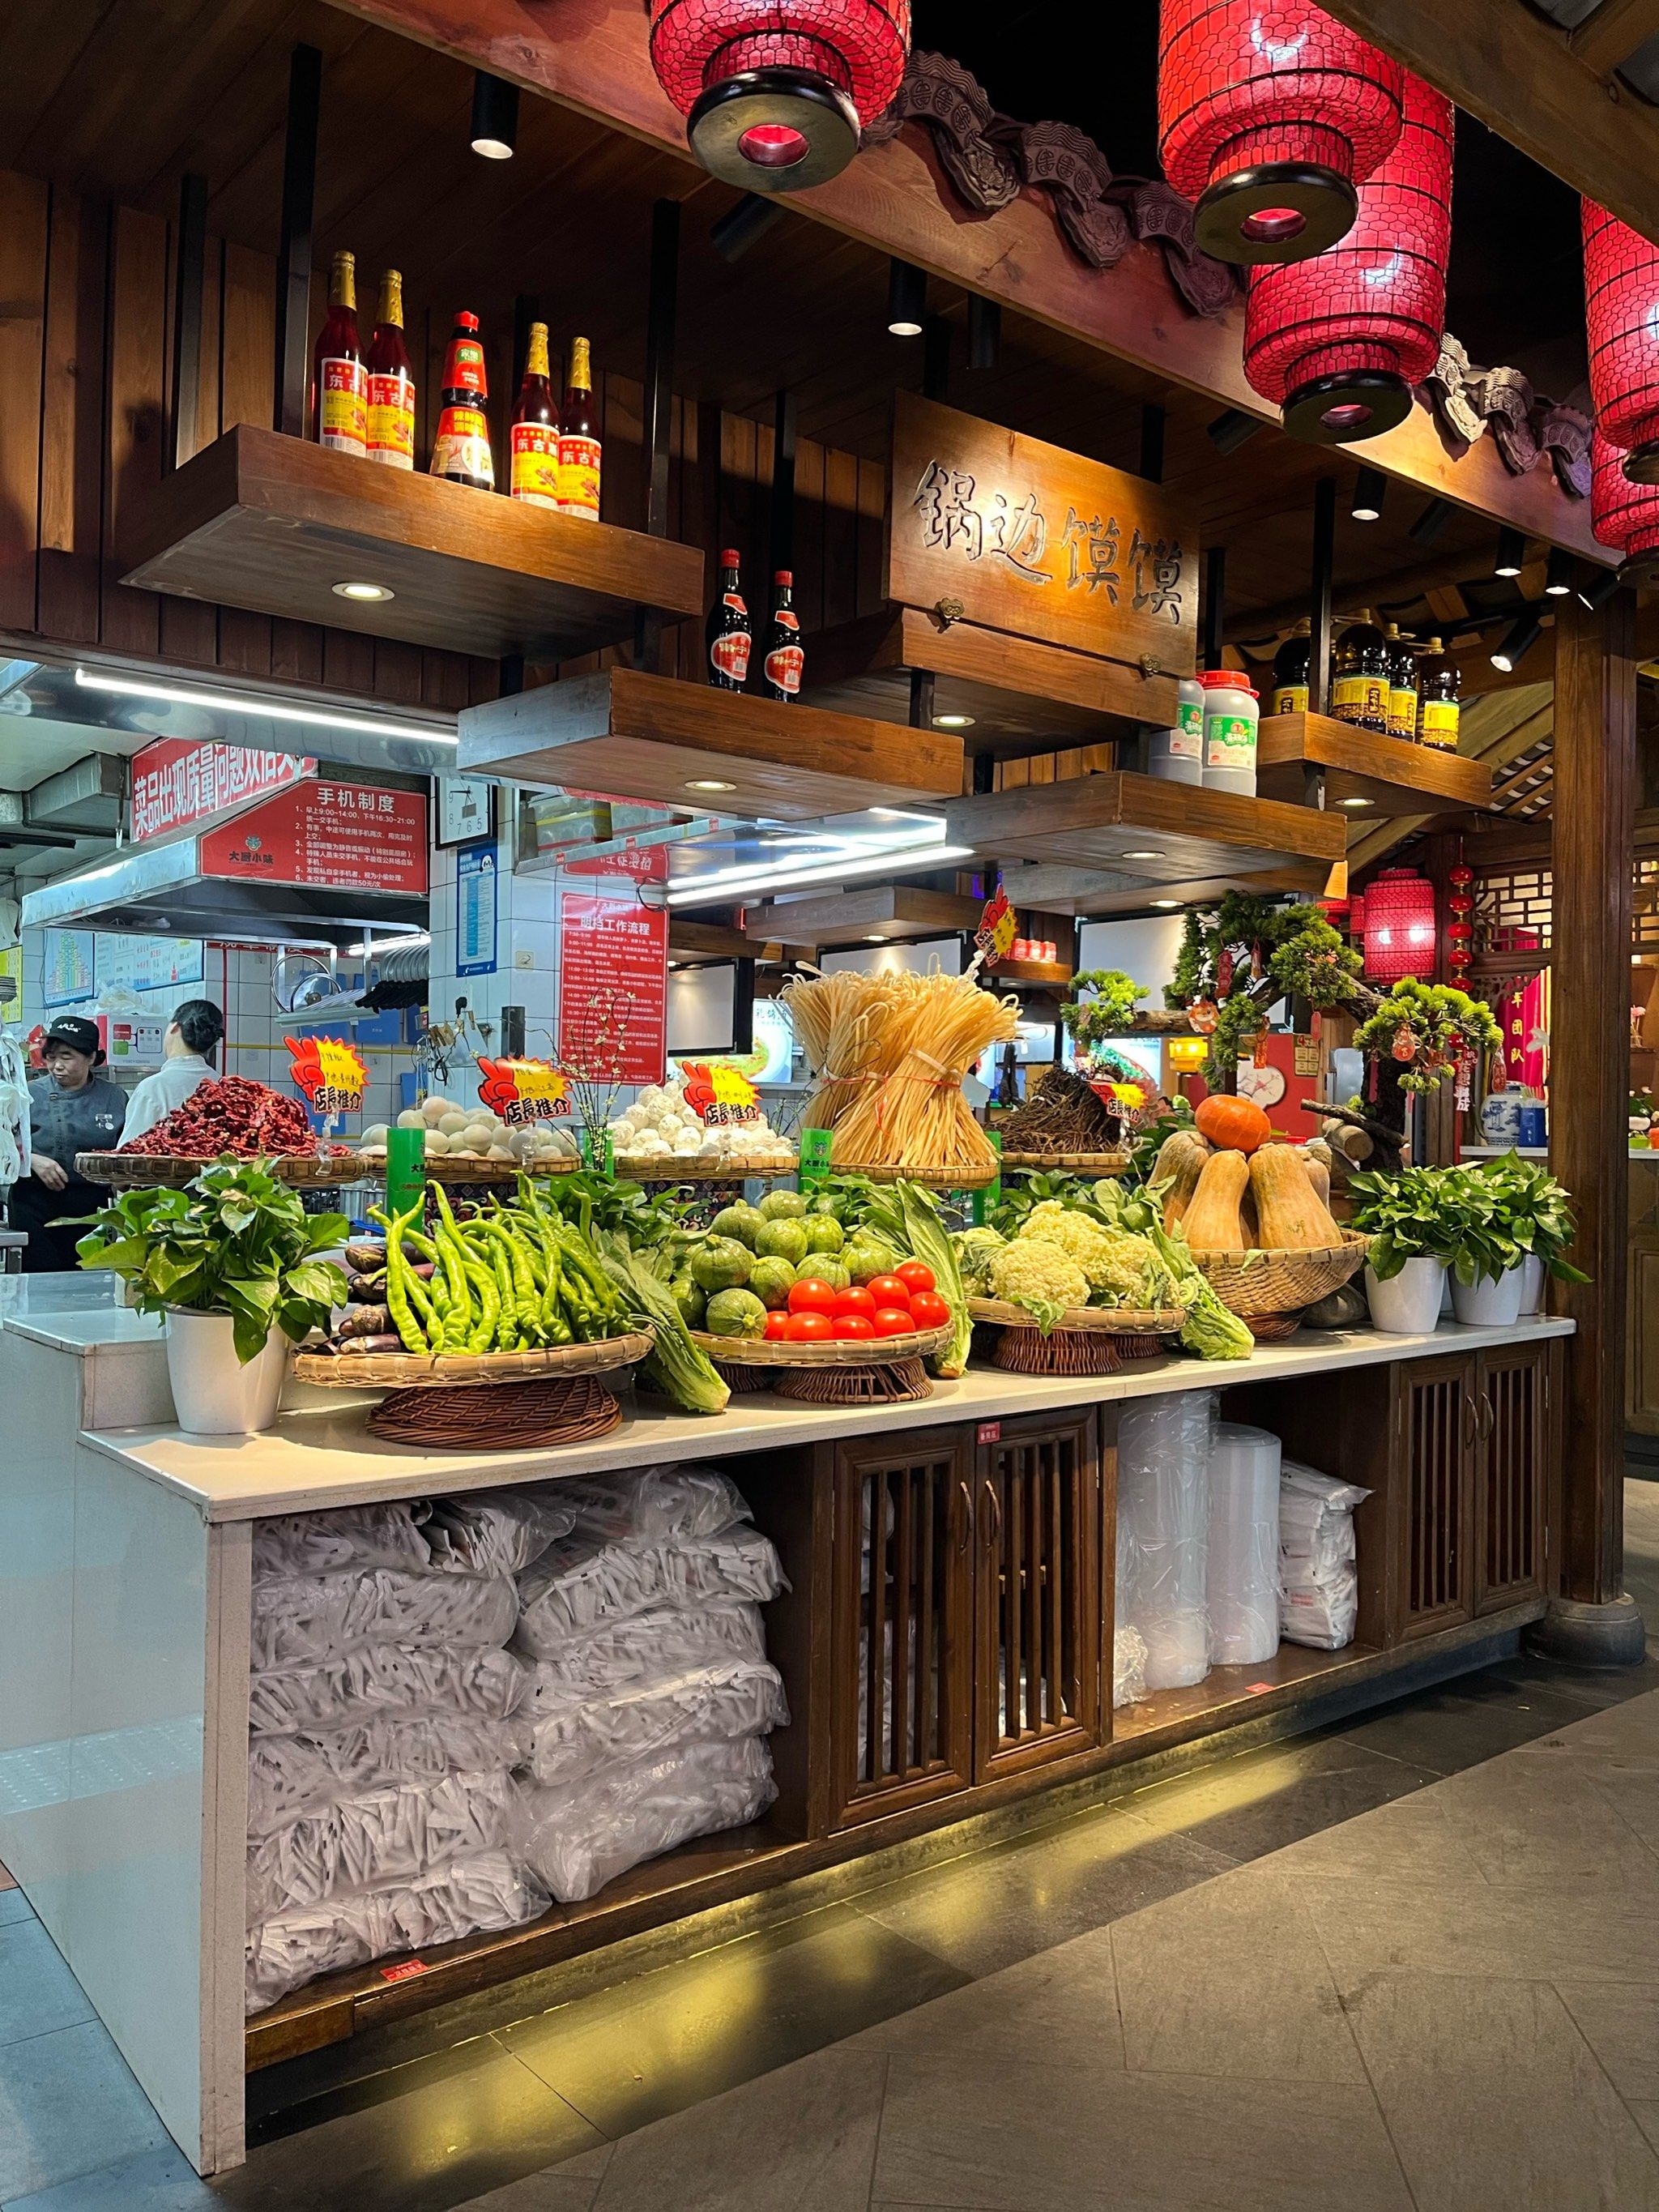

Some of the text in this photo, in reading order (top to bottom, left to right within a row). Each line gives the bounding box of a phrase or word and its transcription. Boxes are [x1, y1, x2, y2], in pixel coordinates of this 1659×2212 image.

[317, 788, 395, 813] 手机制度
[449, 813, 454, 825] 8
[476, 818, 483, 831] 5
[457, 822, 462, 835] 7
[467, 820, 472, 833] 6
